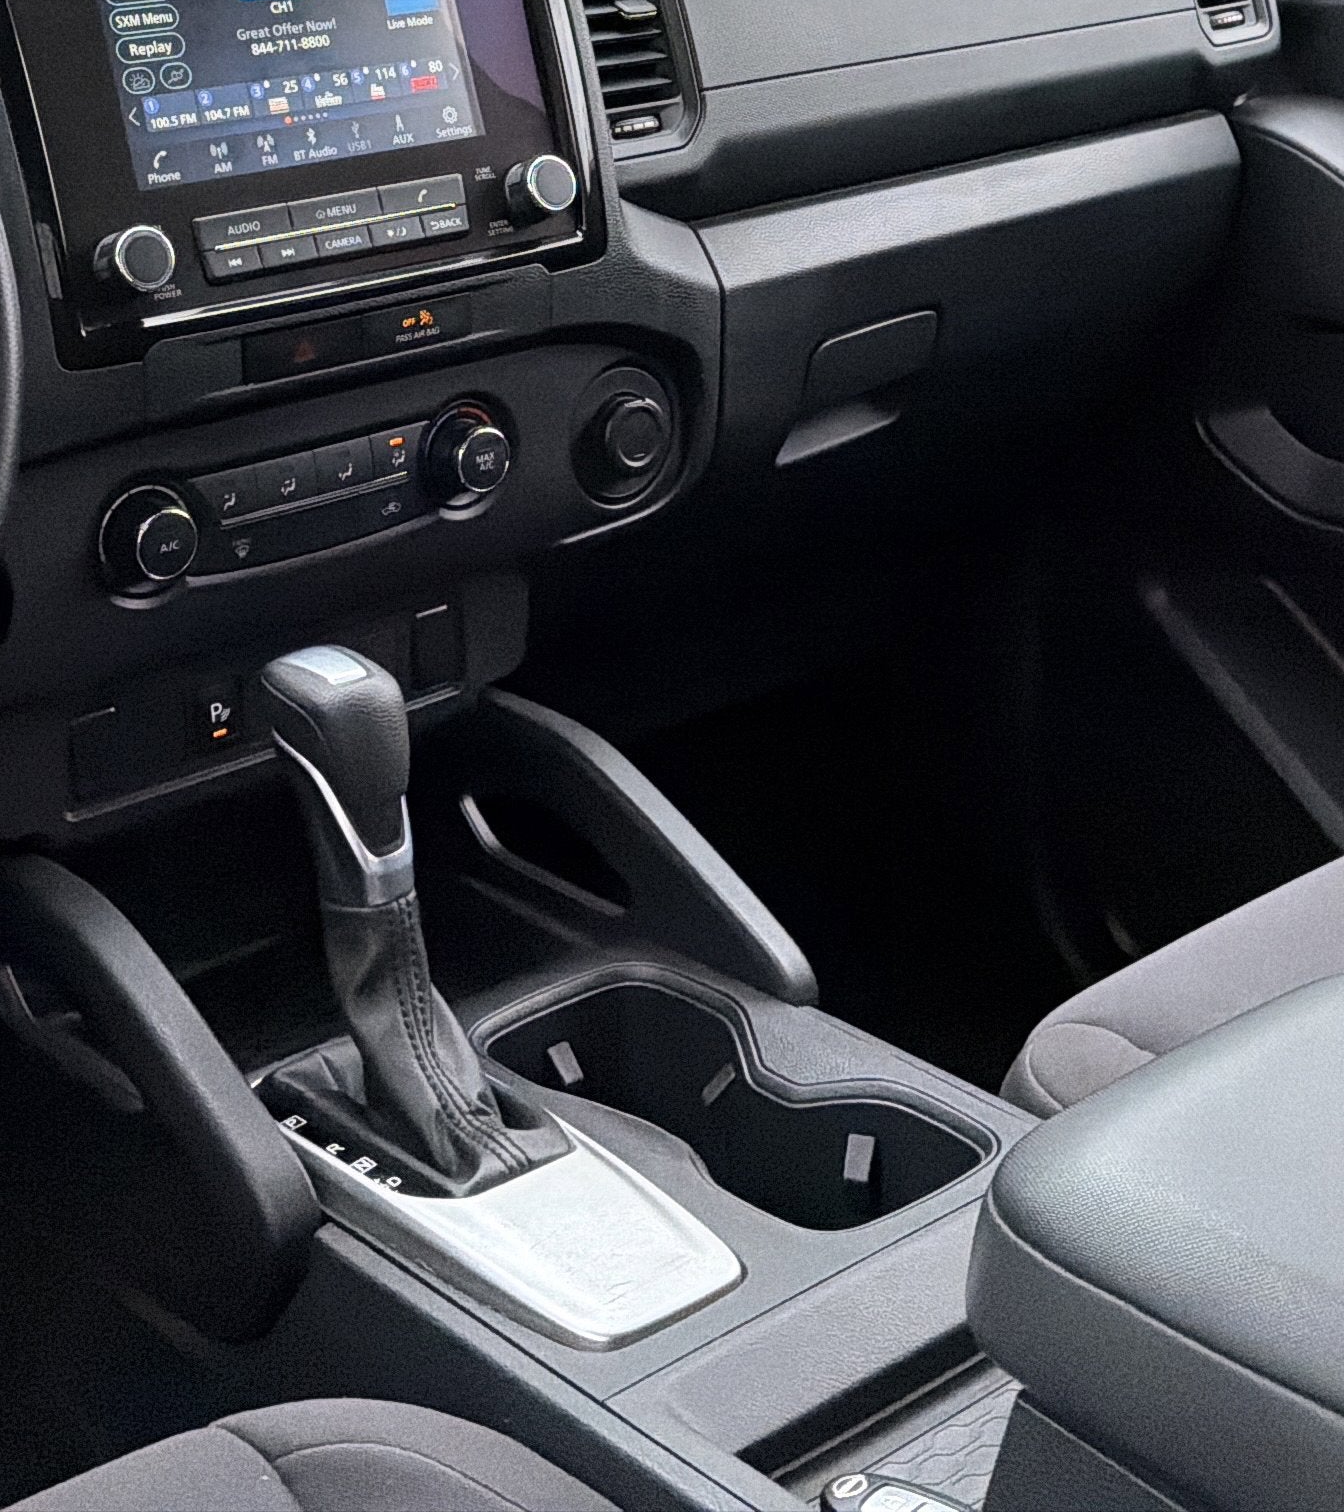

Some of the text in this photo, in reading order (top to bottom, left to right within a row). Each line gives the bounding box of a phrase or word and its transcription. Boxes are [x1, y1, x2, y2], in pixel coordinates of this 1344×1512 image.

[269, 0, 294, 14] CH1
[115, 12, 174, 29] SXM Menu
[386, 15, 434, 30] Live Mode
[236, 17, 337, 41] Great Offer Now!
[128, 40, 173, 57] Replay
[250, 34, 331, 56] 844-711-8800
[374, 66, 397, 81] 114
[428, 60, 443, 74] 80
[282, 79, 299, 94] 25
[332, 72, 349, 87] 56
[150, 112, 197, 129] 100.5 FM
[204, 105, 250, 122] 104.7 FM
[435, 123, 473, 139] Settings
[392, 132, 415, 146] AUX
[261, 154, 279, 167] FM
[294, 144, 338, 162] BT Audio
[214, 161, 233, 174] AM
[147, 171, 181, 185] Phone
[326, 203, 357, 218] MENU
[227, 220, 261, 236] AUDIO
[439, 216, 463, 230] BACK
[325, 234, 363, 250] CAMERA
[153, 289, 183, 300] POWER
[402, 317, 416, 328] OFF
[396, 332, 413, 343] PASS
[413, 329, 425, 339] AIR
[476, 451, 495, 464] MAX
[479, 460, 494, 471] A/C
[159, 539, 180, 554] A/C
[325, 1143, 346, 1155] R
[385, 1176, 403, 1188] D
